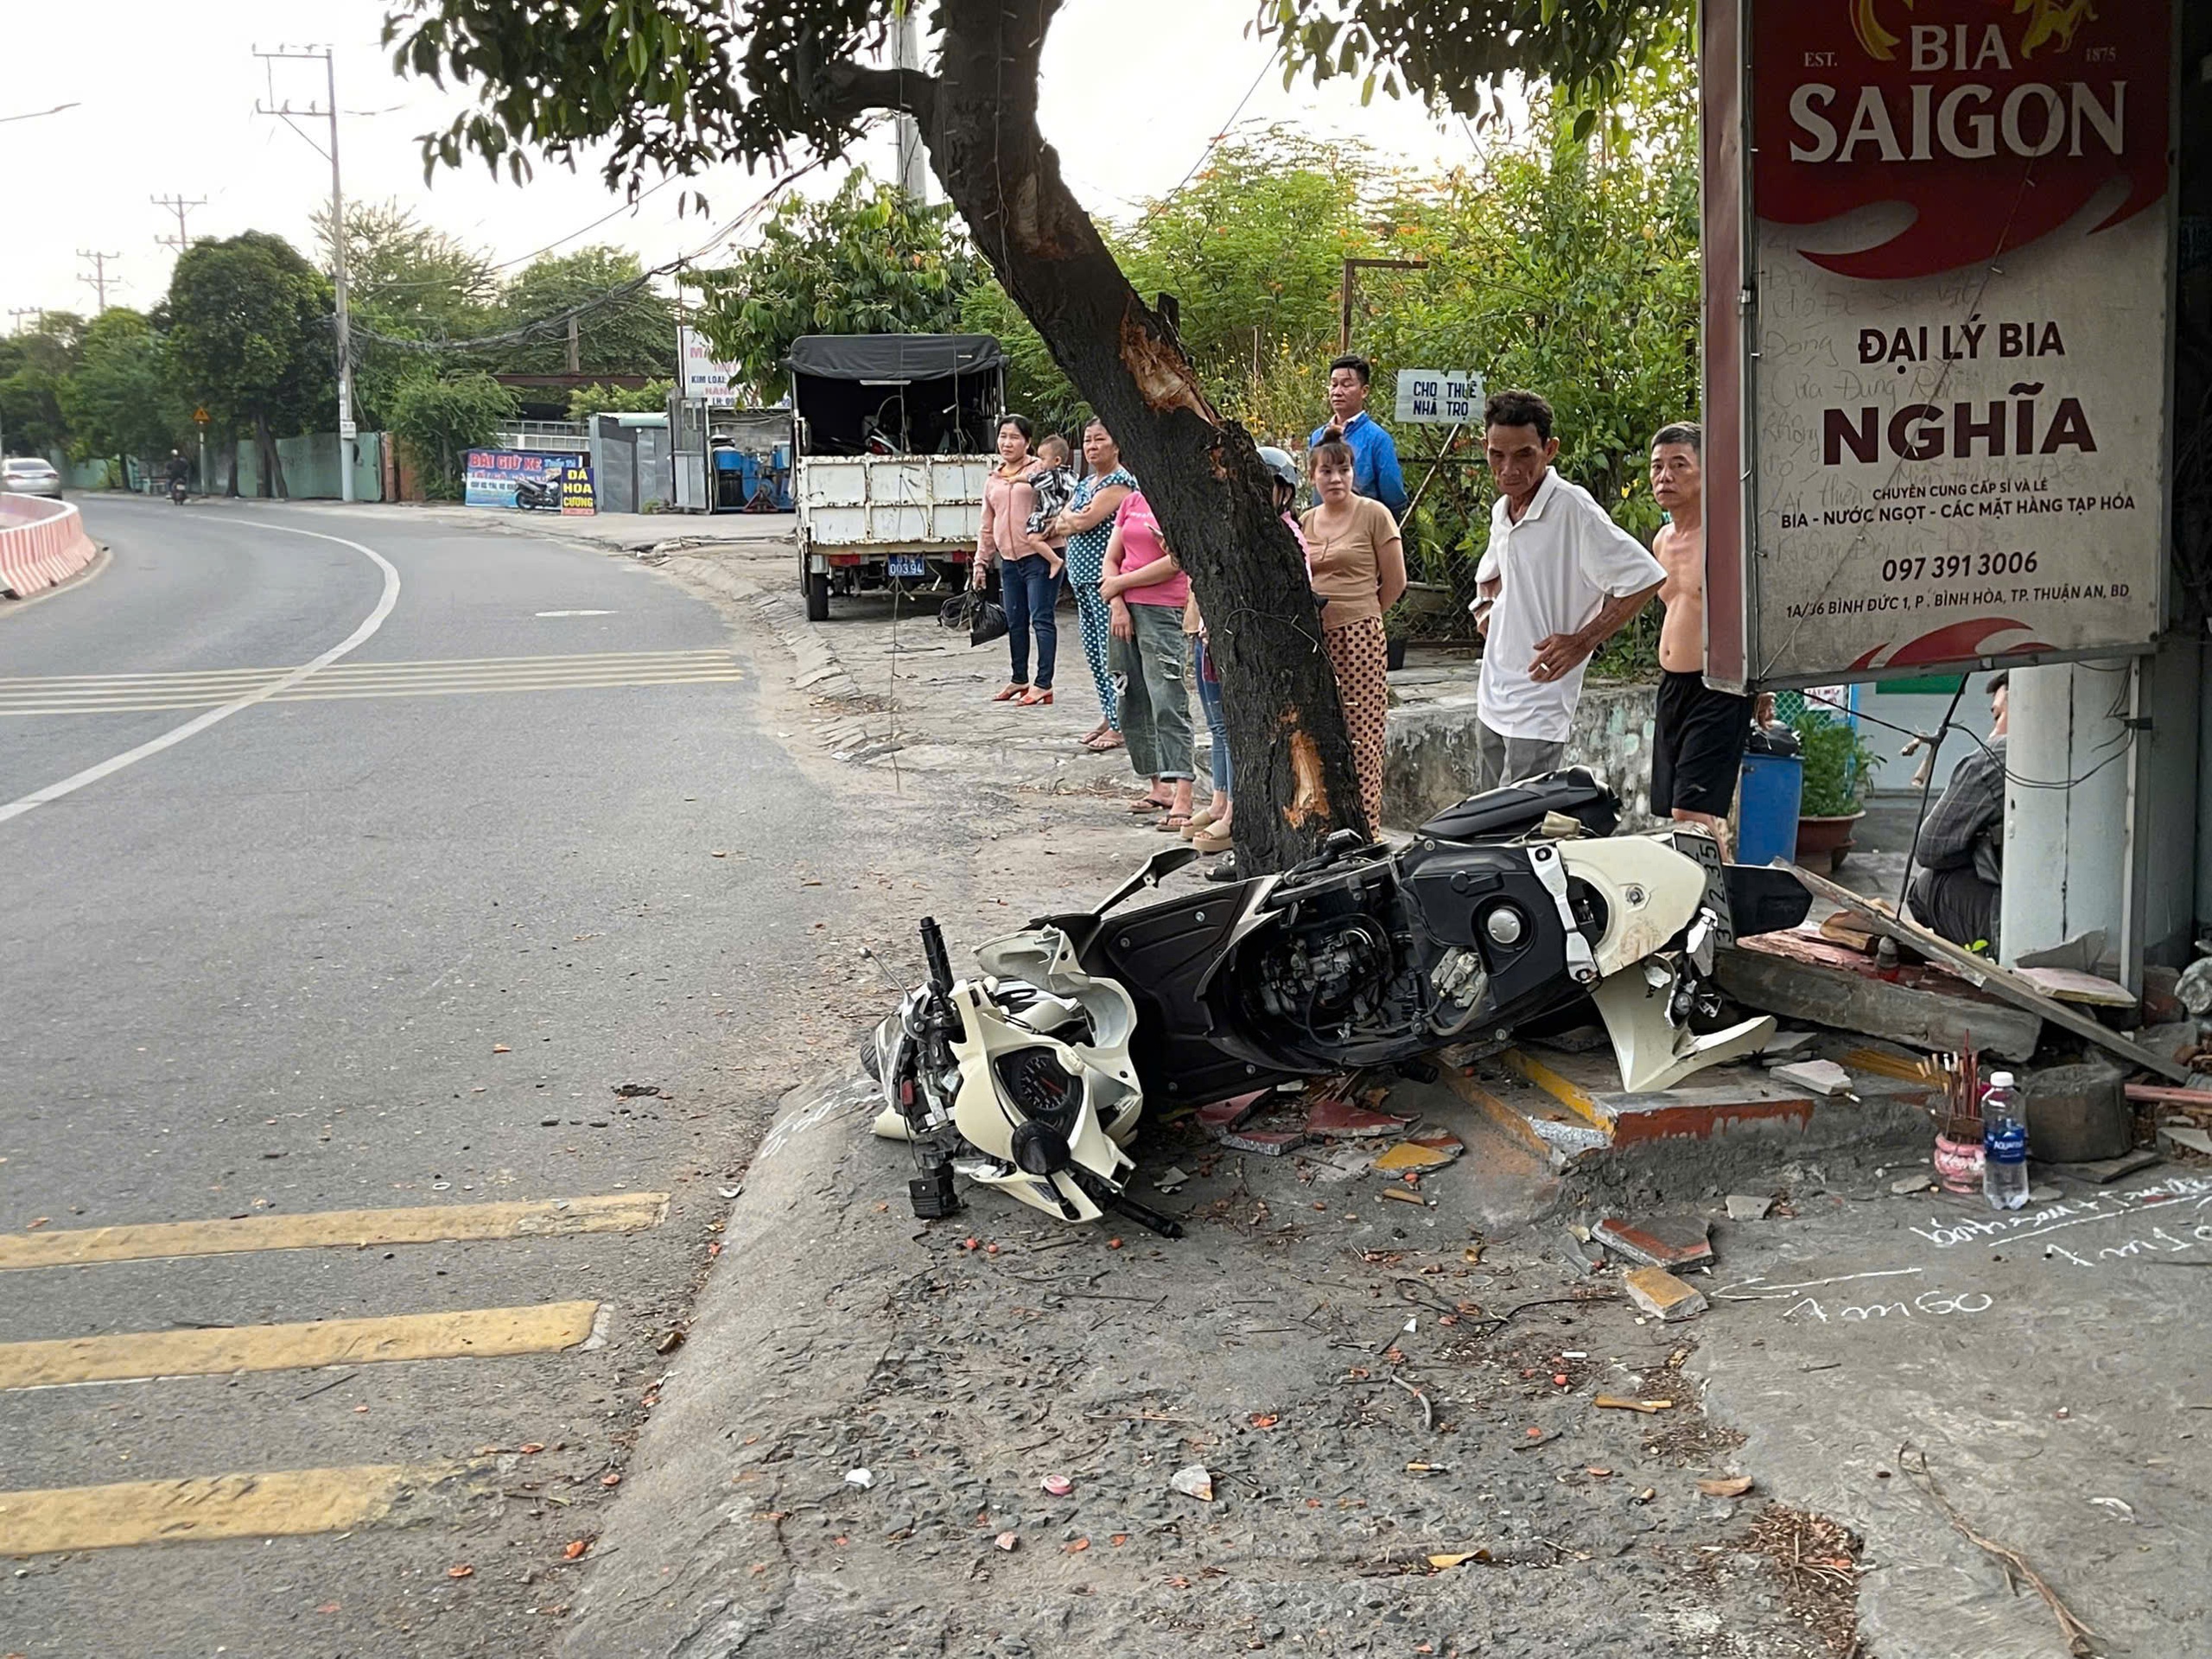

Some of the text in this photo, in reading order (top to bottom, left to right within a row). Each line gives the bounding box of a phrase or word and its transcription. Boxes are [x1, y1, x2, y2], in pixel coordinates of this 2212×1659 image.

[1804, 52, 1838, 67] EST.
[1910, 23, 2012, 72] BIA
[2086, 47, 2117, 63] 1875
[1789, 80, 2128, 163] SAIGON
[1858, 314, 2066, 374] ĐẠI LÝ BIA
[1414, 380, 1477, 398] CHO THUÊ
[1446, 401, 1469, 420] TRỌ
[1823, 382, 2098, 466] NGHĨA
[563, 483, 592, 493] HOA
[1872, 485, 1926, 500] CHUYÊN
[1929, 484, 1967, 498] CUNG
[1970, 478, 1996, 494] CẤP
[2014, 478, 2031, 493] VÀ
[1782, 513, 1808, 529] BIA
[1824, 506, 1875, 526] NƯỚC
[1879, 505, 1926, 524] NGỌT
[1941, 500, 1974, 518] CÁC
[1980, 498, 2012, 519] MẶT
[2017, 496, 2063, 514] HÀNG
[2068, 497, 2096, 516] TẠP
[2101, 492, 2136, 510] HÓA
[1882, 551, 2037, 582] 097 391 3006
[1828, 598, 1864, 614] BÌNH
[1867, 594, 1899, 612] ĐỨC
[1904, 597, 1911, 612] 1,
[1935, 592, 1969, 607] BÌNH
[2011, 589, 2029, 602] TP.
[2034, 583, 2081, 603] THUẬN
[2083, 585, 2107, 600] AN,
[2111, 584, 2129, 598] BD
